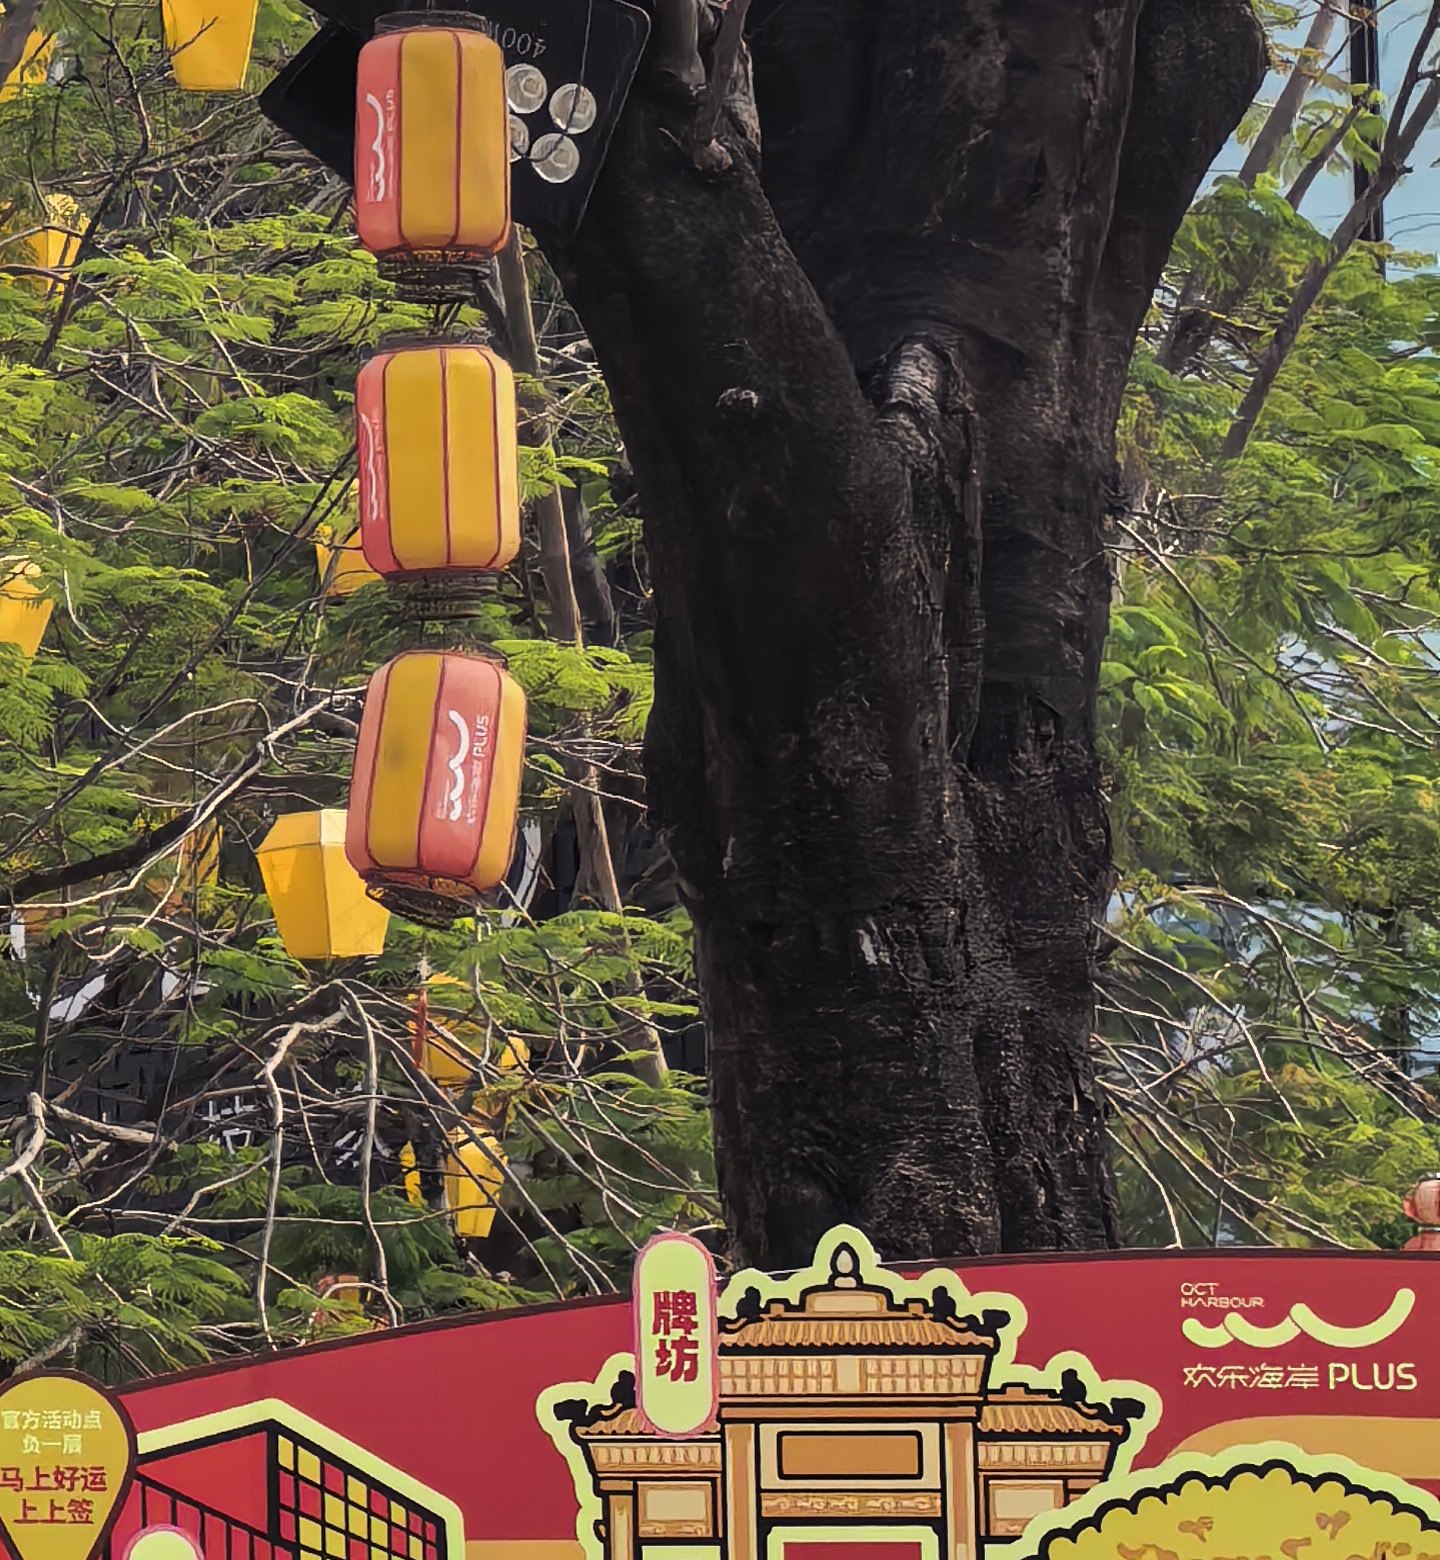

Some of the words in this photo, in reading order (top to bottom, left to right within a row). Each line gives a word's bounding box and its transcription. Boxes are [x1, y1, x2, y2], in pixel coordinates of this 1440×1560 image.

[1180, 1282, 1220, 1297] OCT
[1180, 1296, 1266, 1309] HARBOUR
[652, 1289, 700, 1383] 牌坊
[1182, 1362, 1320, 1390] 欢乐海岸
[1327, 1362, 1419, 1391] PLUS
[1, 1409, 103, 1431] 官方活动点
[22, 1433, 83, 1455] 负一层
[13, 1498, 95, 1525] 上上签
